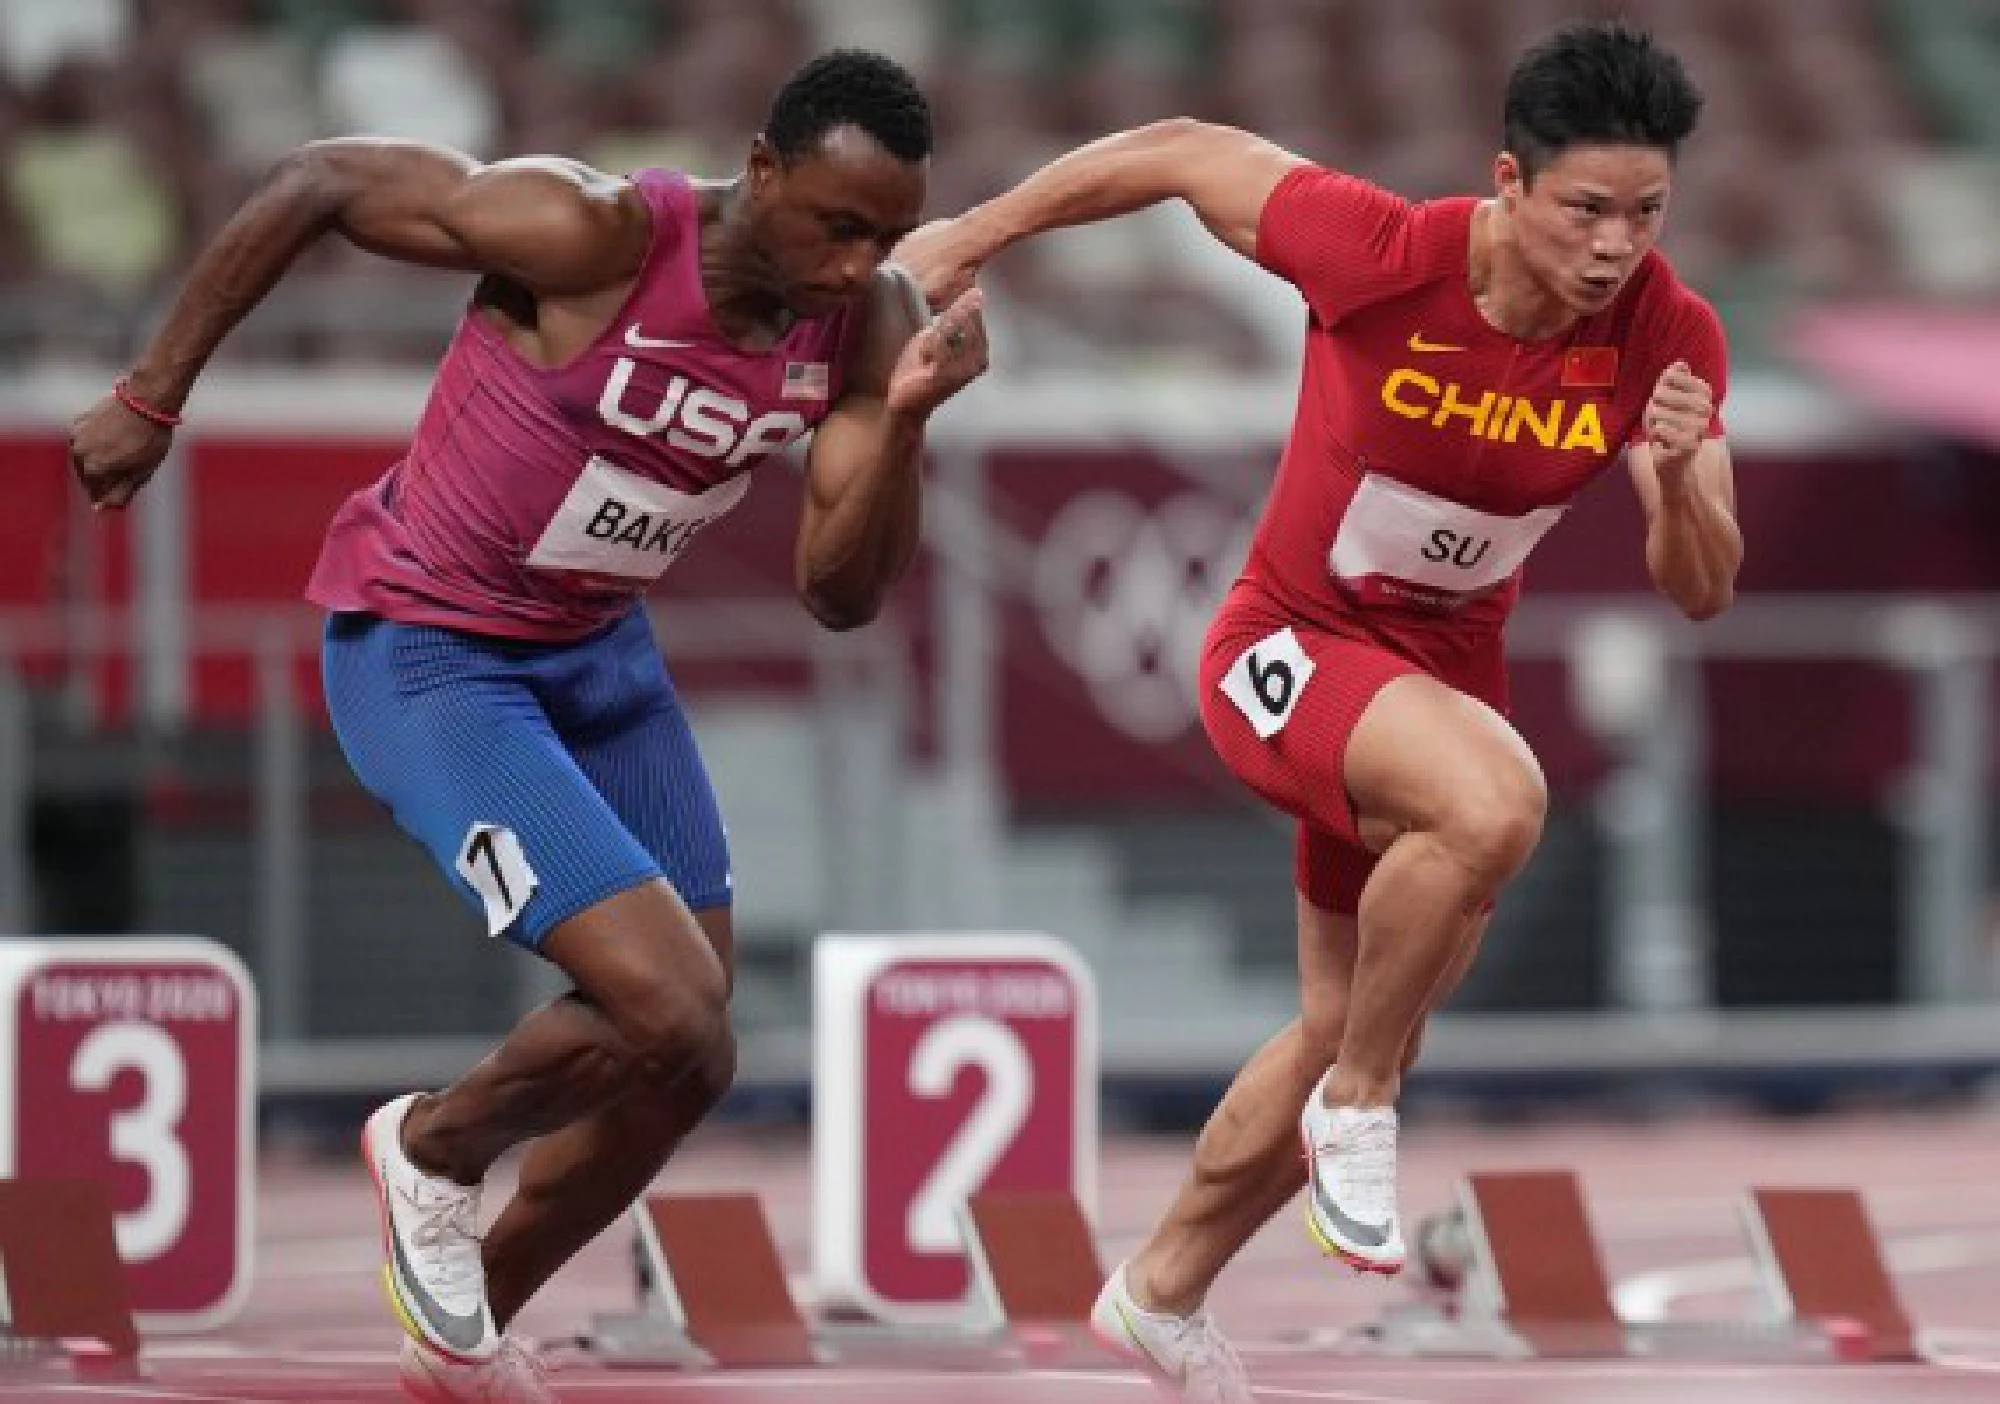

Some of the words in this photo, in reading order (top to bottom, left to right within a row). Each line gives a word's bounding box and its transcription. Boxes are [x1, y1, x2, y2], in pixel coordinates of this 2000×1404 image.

[597, 357, 810, 464] USA
[1382, 369, 1607, 453] CHINA
[1420, 530, 1491, 568] SU
[1248, 652, 1295, 716] 6
[69, 1022, 193, 1263] 3
[906, 1018, 1035, 1254] 2
